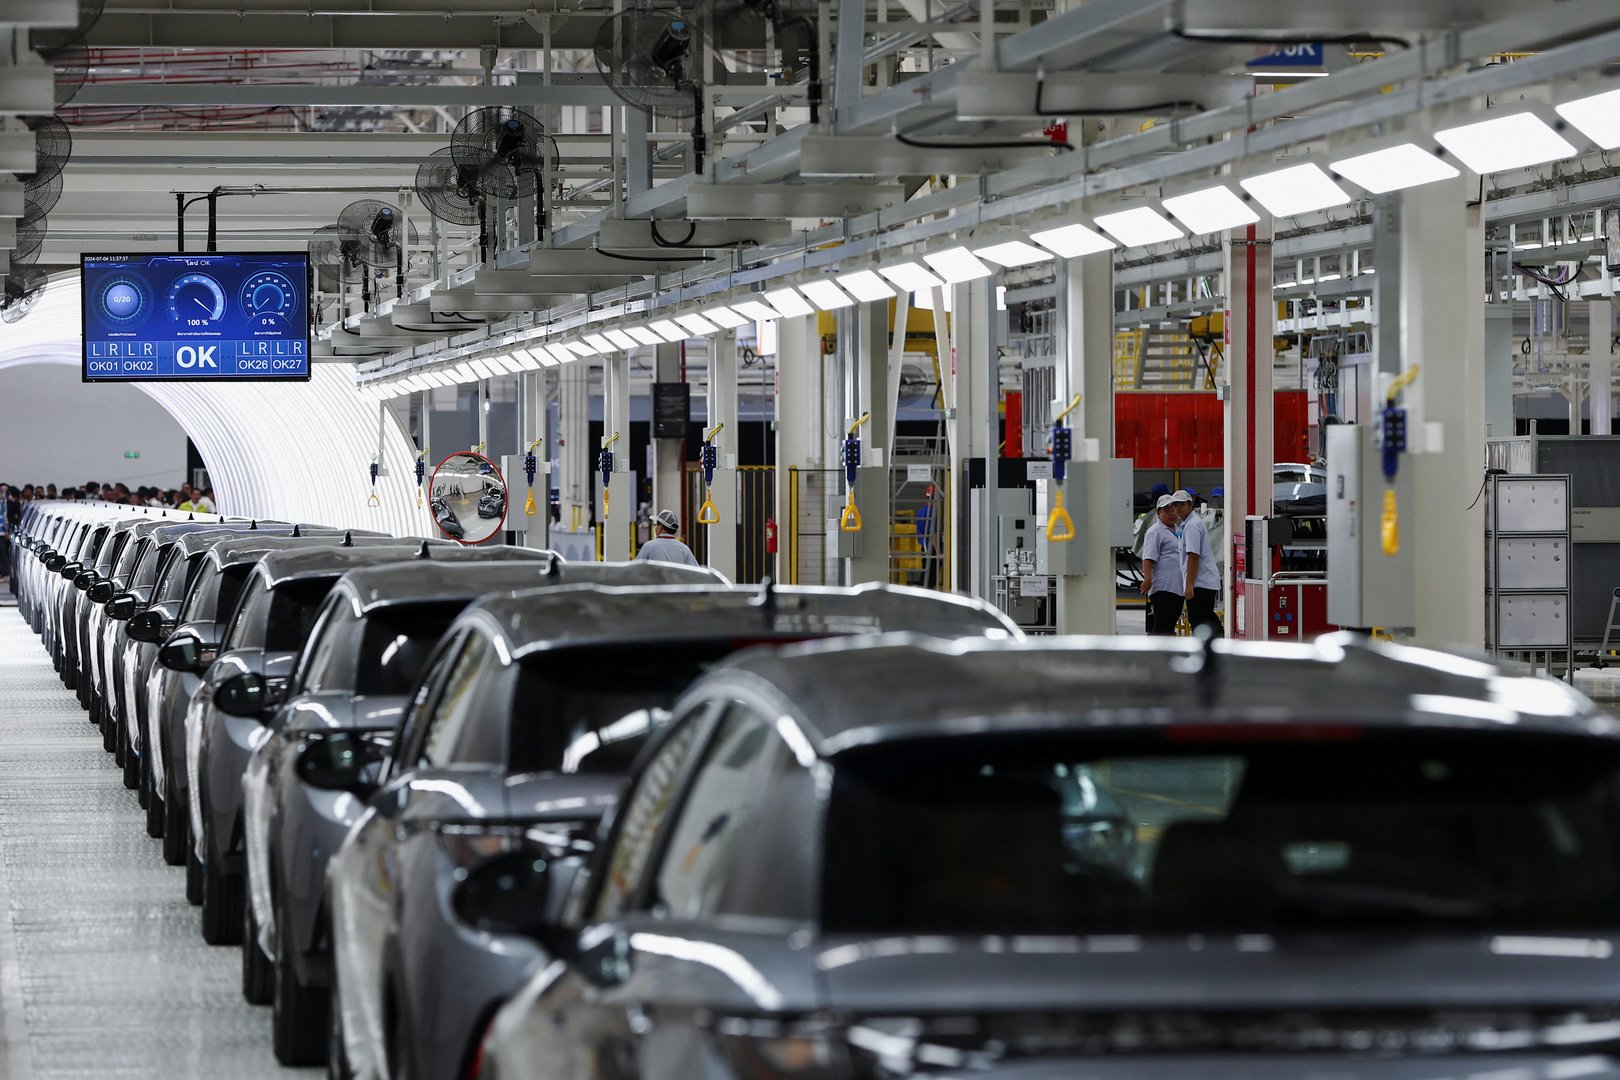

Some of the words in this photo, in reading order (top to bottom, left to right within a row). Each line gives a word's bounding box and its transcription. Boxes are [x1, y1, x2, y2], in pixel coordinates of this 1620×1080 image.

[93, 344, 100, 356] L
[110, 344, 118, 356] R
[128, 344, 135, 356] L
[144, 344, 152, 355] R
[243, 342, 250, 354] L
[259, 342, 267, 354] R
[277, 342, 283, 354] L
[294, 342, 302, 354] R
[176, 346, 217, 368] OK
[89, 362, 119, 371] OK01
[124, 361, 153, 371] OK02
[239, 360, 268, 370] OK26
[273, 359, 302, 369] OK27
